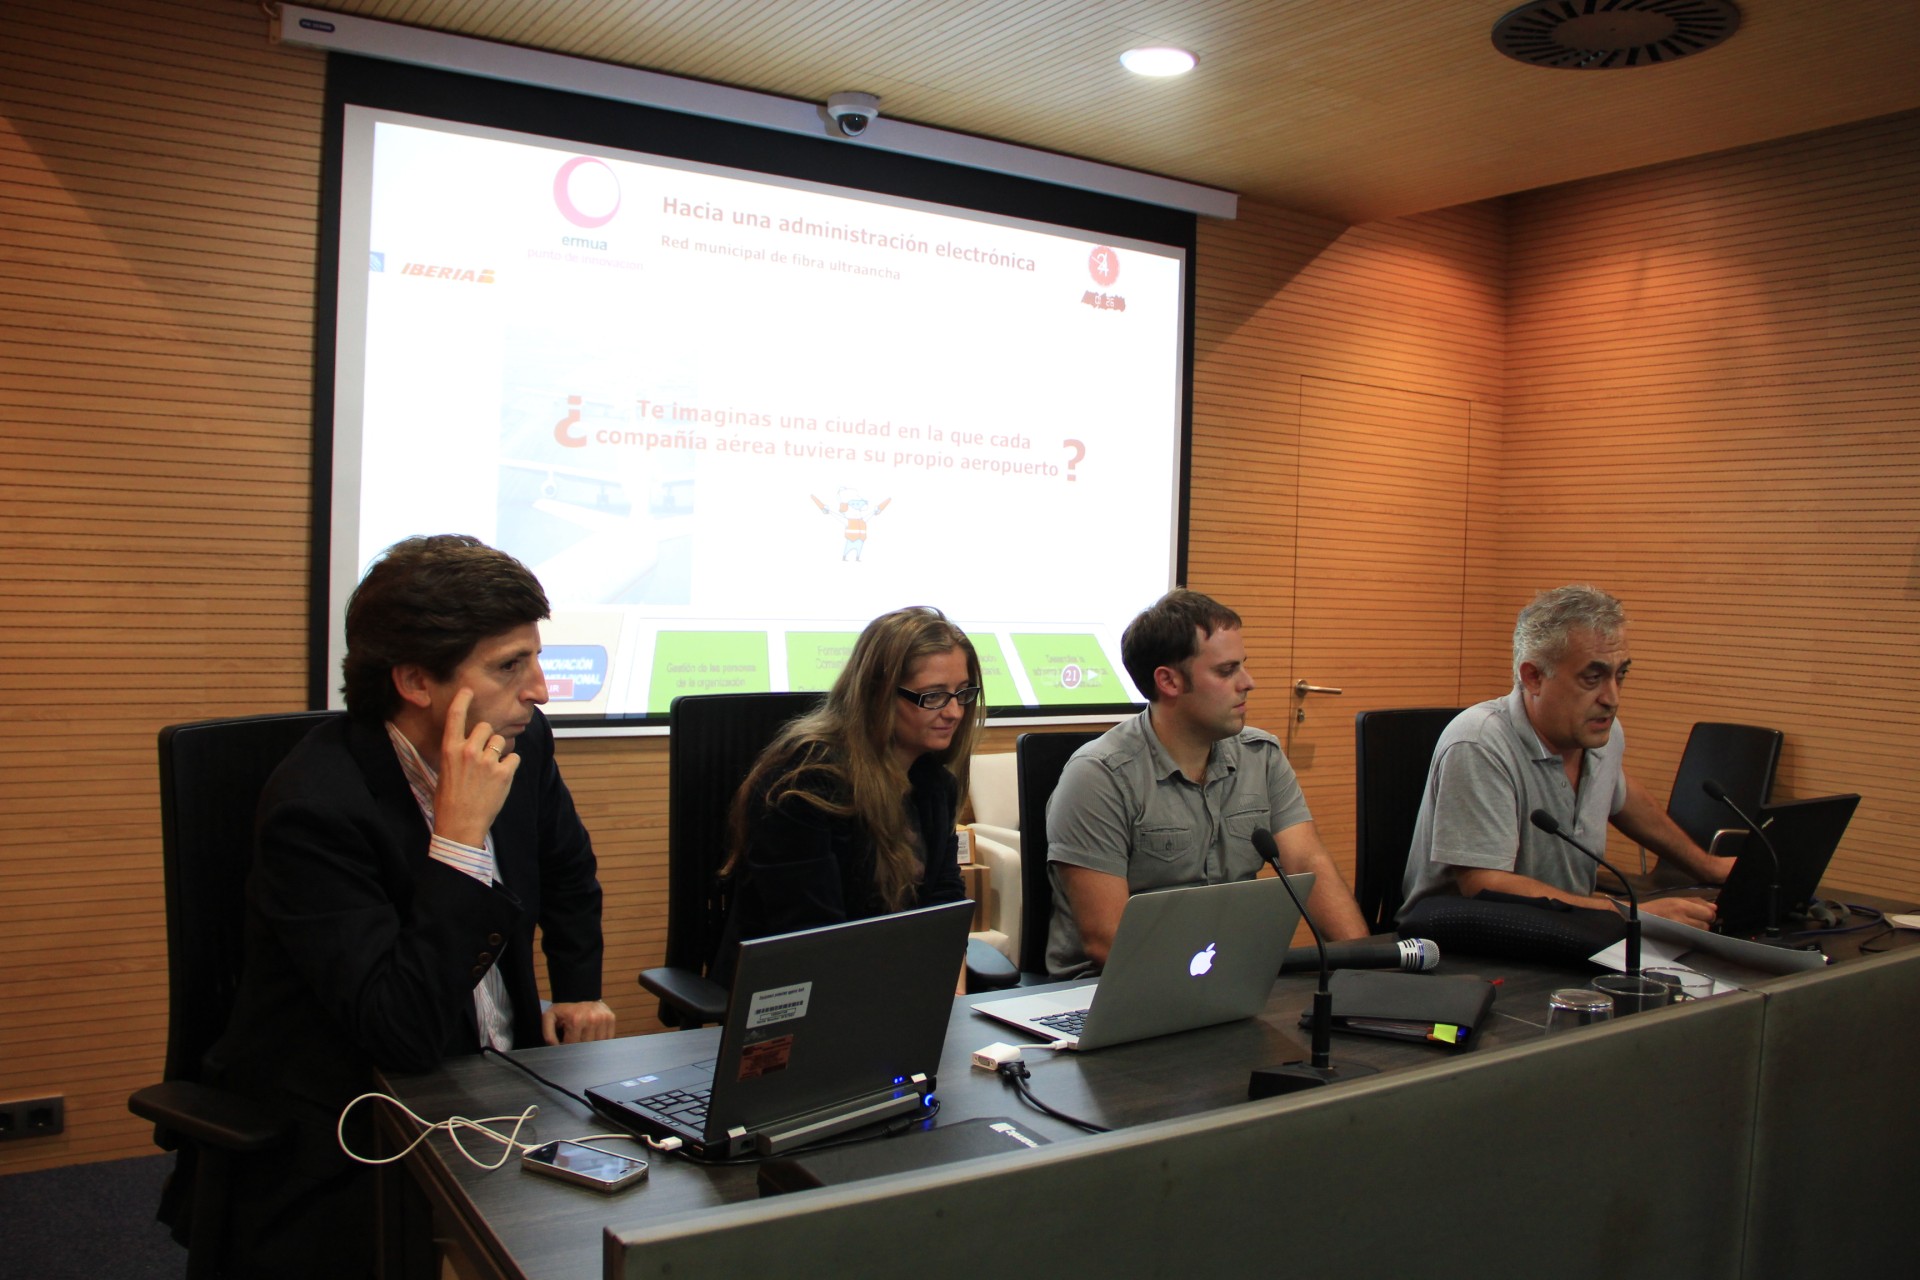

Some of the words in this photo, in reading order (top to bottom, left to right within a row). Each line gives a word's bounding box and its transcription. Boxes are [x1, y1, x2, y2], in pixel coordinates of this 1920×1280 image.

[561, 235, 608, 251] ermua
[660, 234, 690, 250] Red
[694, 241, 766, 261] municipal
[770, 250, 787, 263] de
[792, 253, 825, 270] fibra
[829, 260, 901, 281] ultraancha
[662, 196, 724, 222] Hacia
[732, 210, 772, 229] una
[778, 217, 929, 254] administración
[935, 240, 1036, 272] electrónica
[400, 262, 476, 283] IBERIA
[636, 400, 665, 420] Te
[672, 402, 772, 428] imaginas
[780, 415, 818, 431] una
[825, 415, 891, 438] ciudad
[897, 424, 921, 440] en
[927, 424, 944, 442] la
[950, 429, 984, 447] que
[990, 433, 1031, 450] cada
[595, 429, 707, 451] compañía
[715, 434, 776, 456] aérea
[783, 440, 857, 461] tuviera
[863, 449, 886, 463] su
[893, 450, 954, 471] propio
[960, 455, 1059, 477] aeropuerto
[1064, 669, 1078, 683] 21
